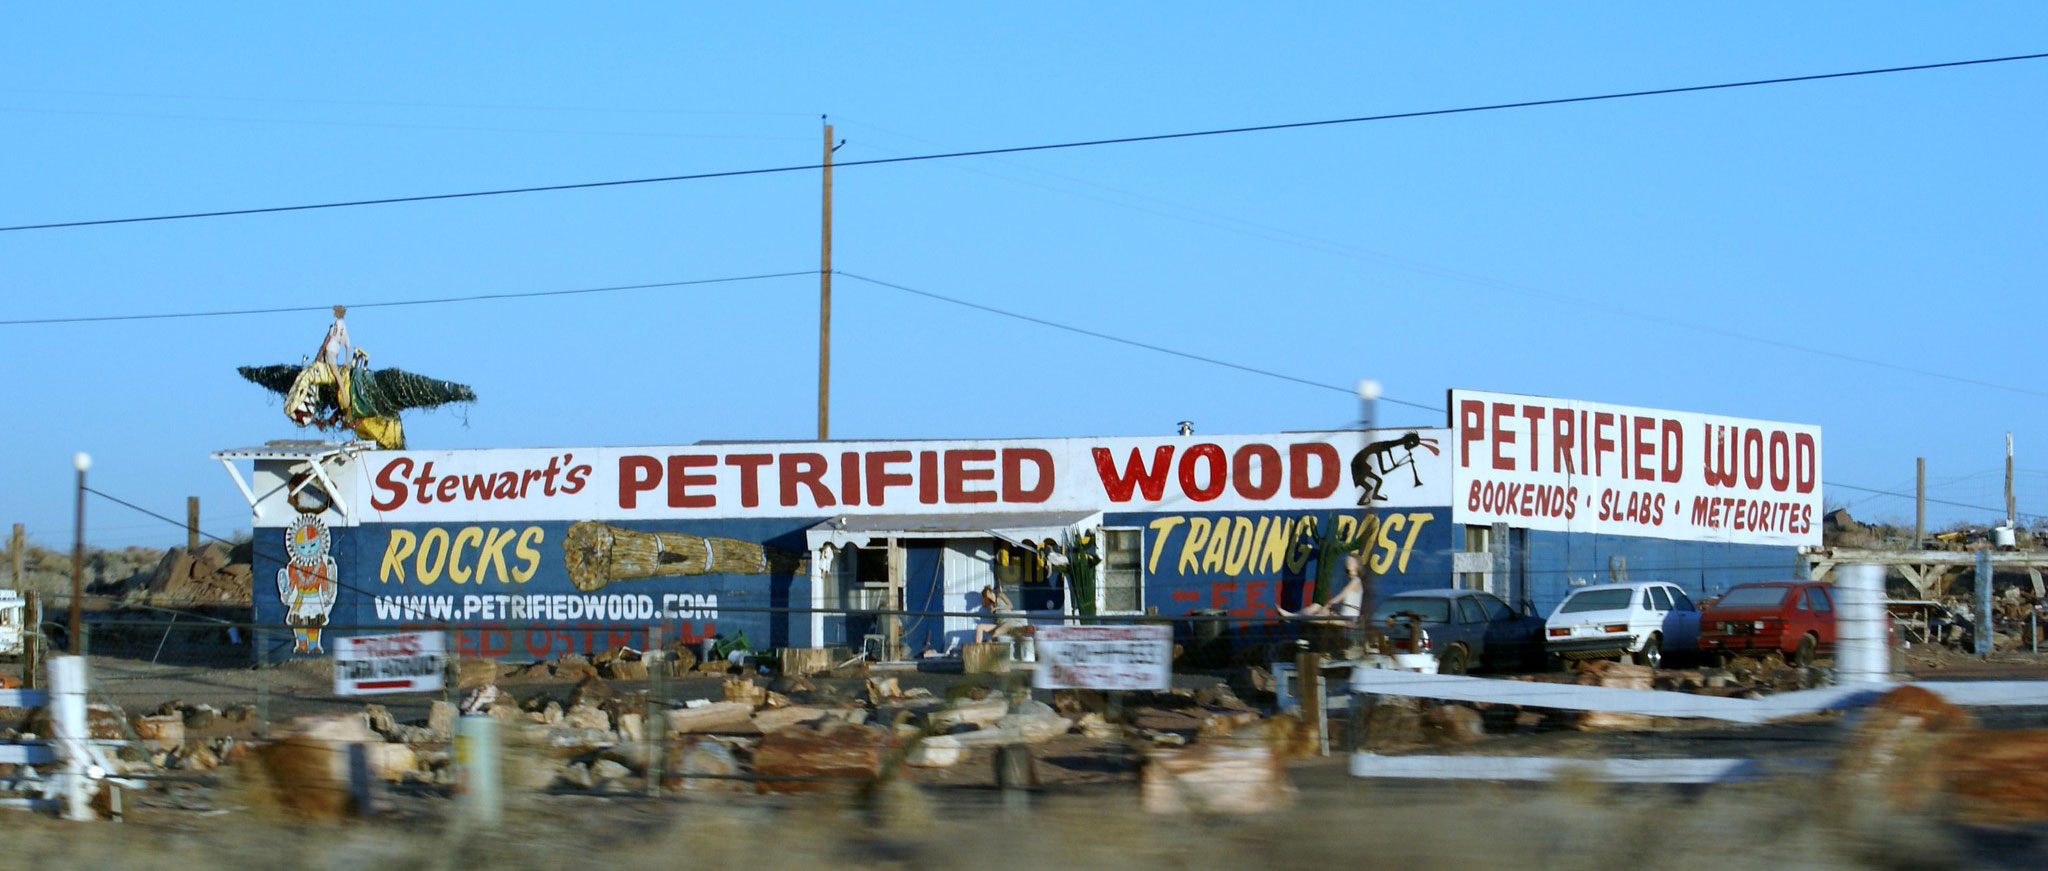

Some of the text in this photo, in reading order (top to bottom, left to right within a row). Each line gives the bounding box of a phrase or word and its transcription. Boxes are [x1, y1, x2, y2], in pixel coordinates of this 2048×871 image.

[370, 442, 1342, 512] Stewart's PETRIFIED WOOD
[1460, 400, 1816, 494] PETRIFIED WOOD
[1467, 479, 1812, 534] BOOKENDS SLABS METEORITES
[379, 526, 545, 586] ROCKS
[1148, 515, 1319, 577] TRADING
[1337, 512, 1435, 576] POST
[374, 593, 719, 621] WWW.PETRIFIEDWOOD.COM
